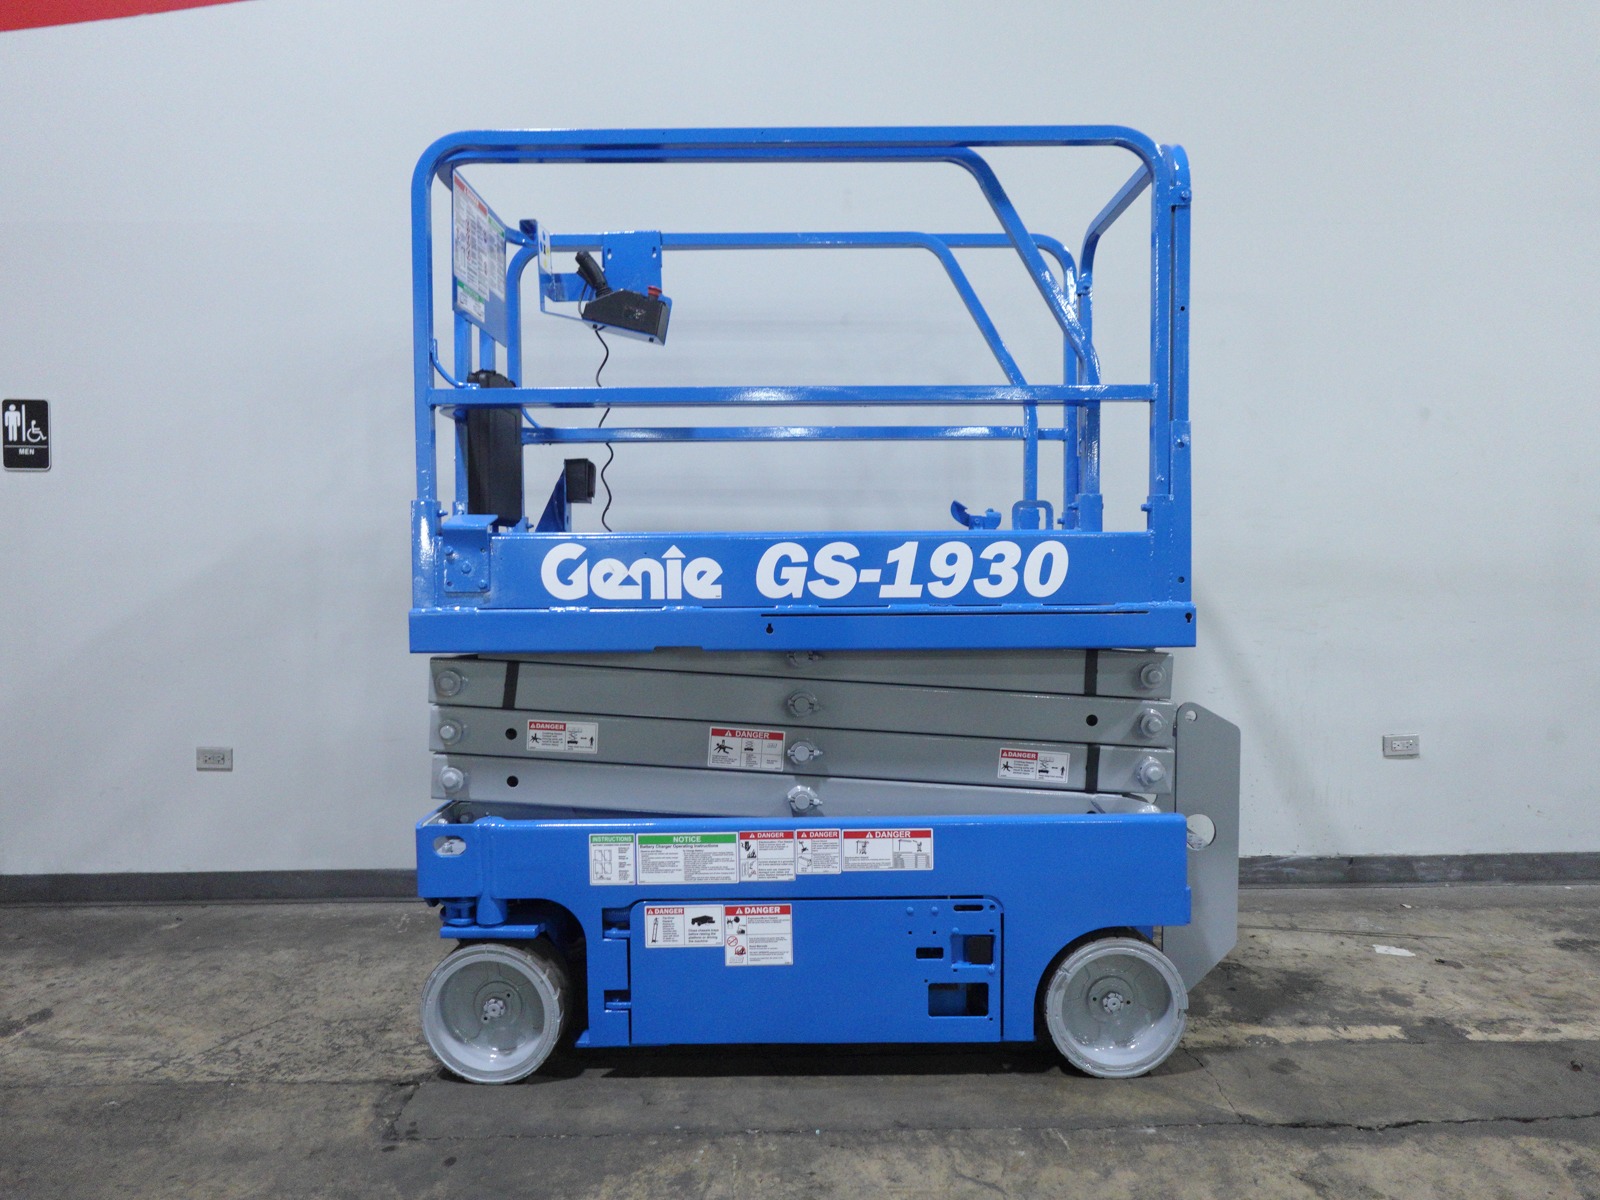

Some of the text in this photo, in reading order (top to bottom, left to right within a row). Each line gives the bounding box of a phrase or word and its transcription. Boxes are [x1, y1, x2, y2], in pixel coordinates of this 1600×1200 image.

[540, 540, 1069, 601] Genie GS-1930
[735, 730, 770, 739] DANGER
[673, 835, 702, 843] NOTICE
[744, 906, 781, 914] DANGER
